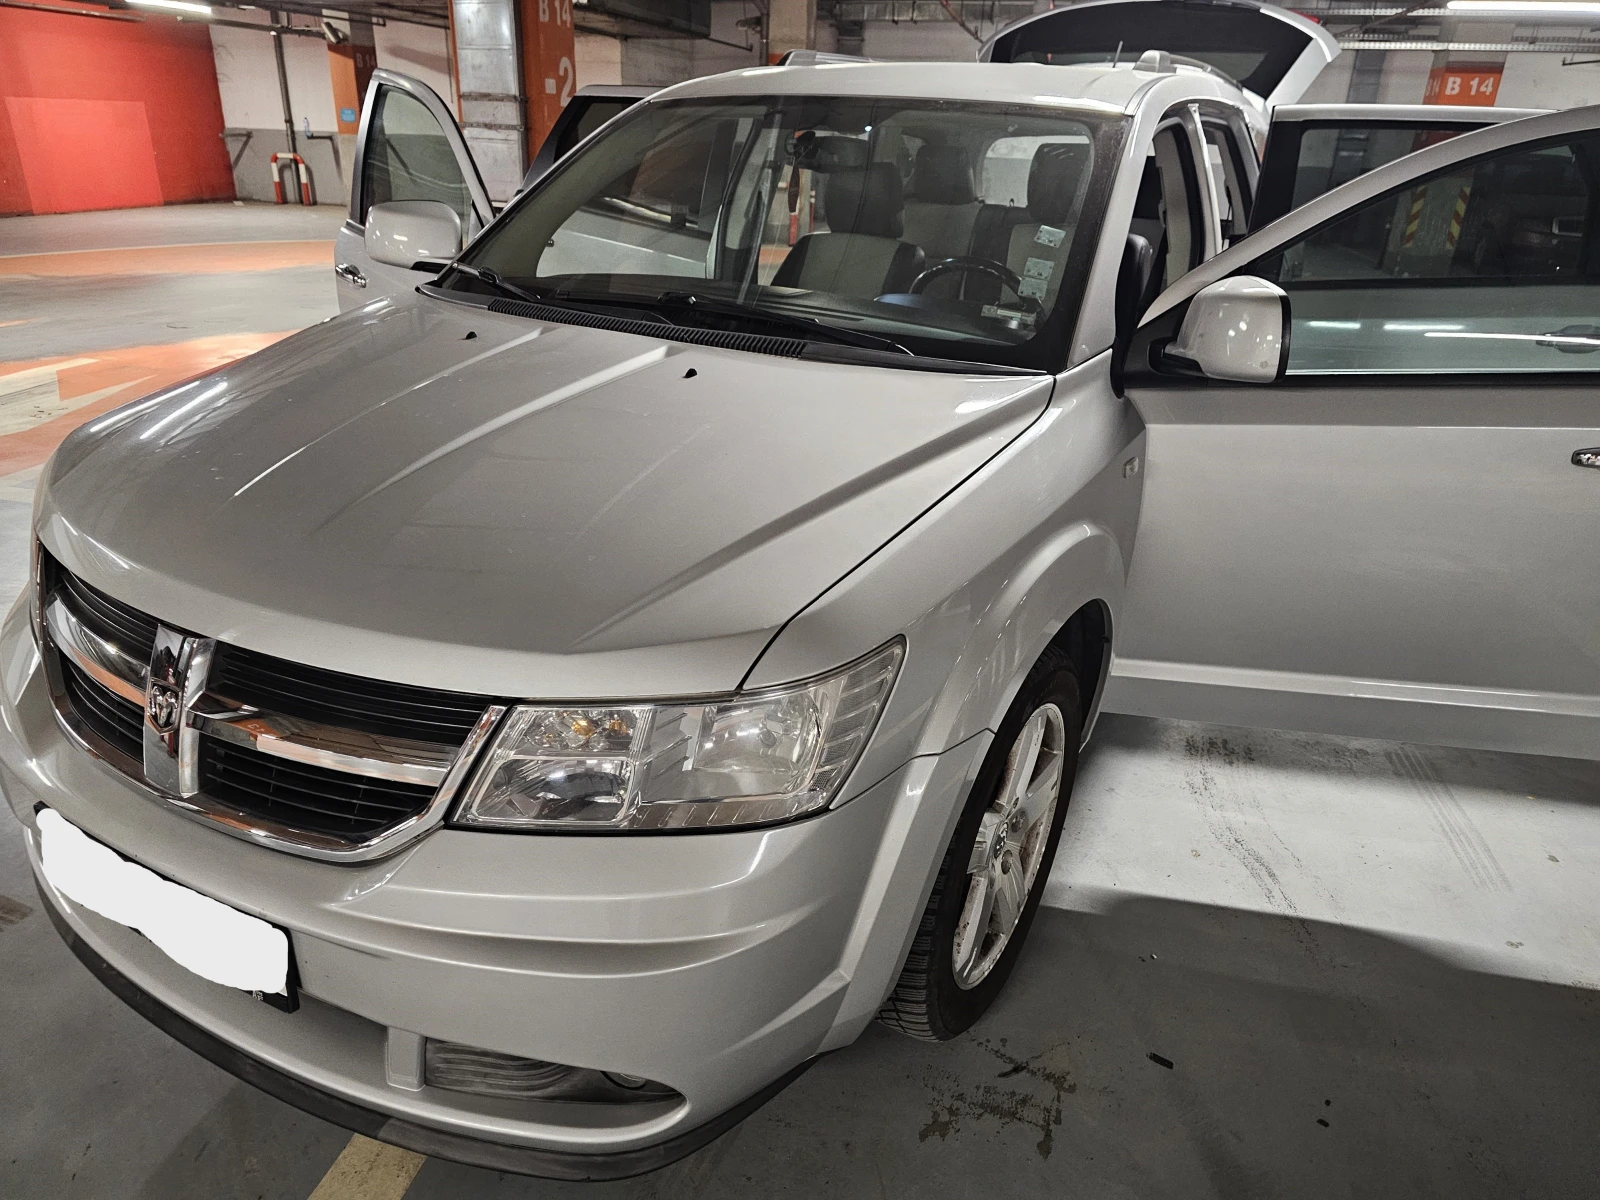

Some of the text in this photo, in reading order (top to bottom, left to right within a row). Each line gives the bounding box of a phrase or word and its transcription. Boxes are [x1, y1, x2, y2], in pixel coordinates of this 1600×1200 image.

[539, 0, 571, 28] B 14
[1445, 77, 1462, 95] B
[1469, 77, 1494, 95] 14
